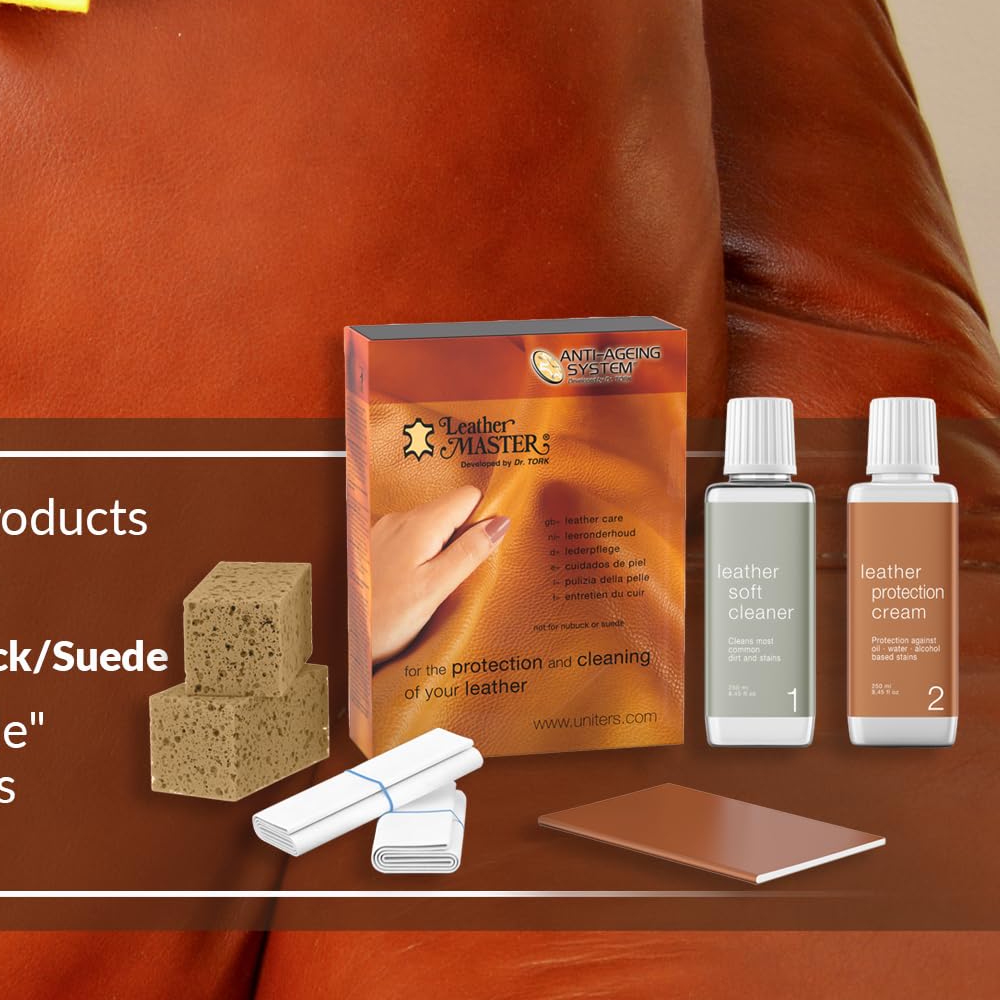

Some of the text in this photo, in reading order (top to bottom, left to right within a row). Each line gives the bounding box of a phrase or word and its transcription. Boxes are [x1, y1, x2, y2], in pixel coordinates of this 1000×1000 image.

[560, 346, 661, 362] ANTI-AGEING
[438, 416, 516, 436] Leather
[461, 457, 550, 469] Developed by Dr. TORK
[564, 514, 600, 525] leather
[601, 514, 624, 523] care
[564, 528, 637, 541] leeronderhoud
[564, 545, 621, 557] lederpflege
[564, 561, 610, 572] cuidados
[613, 559, 626, 569] de
[628, 558, 647, 569] piel
[717, 563, 780, 580] leather
[860, 563, 922, 580] leather
[564, 576, 597, 588] pulizia
[599, 574, 624, 585] della
[626, 573, 651, 584] pelle
[564, 591, 609, 602] entretien
[611, 589, 624, 599] du
[626, 588, 646, 599] cuir
[728, 583, 763, 601] soft
[872, 583, 945, 603] protection
[728, 604, 795, 620] cleaner
[872, 606, 927, 620] cream
[561, 621, 589, 631] nubuck
[728, 637, 774, 645] Cleans most
[872, 636, 937, 646] Protection against
[872, 645, 881, 653] oil
[914, 645, 941, 653] alcohol
[404, 649, 651, 678] for the protection and cleaning
[871, 653, 918, 661] based stains
[404, 679, 529, 702] of your leather
[927, 685, 945, 711] 2
[786, 687, 797, 713] 1
[533, 711, 658, 731] www.uniters.com
